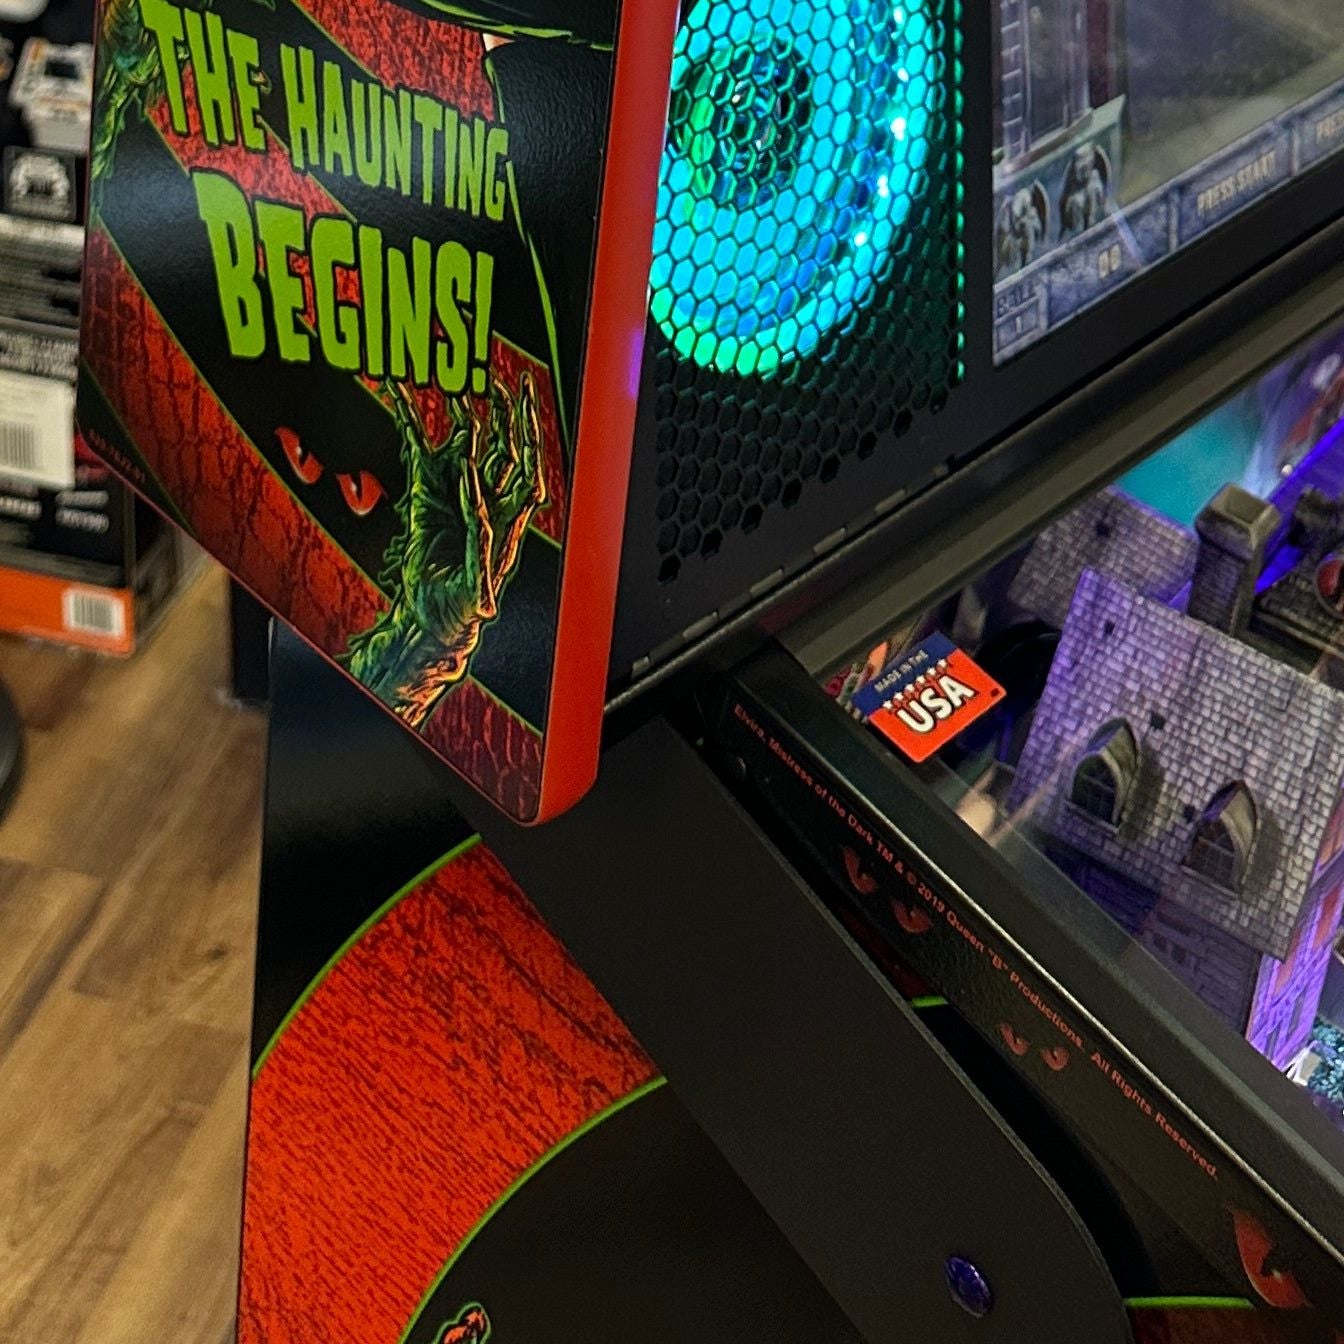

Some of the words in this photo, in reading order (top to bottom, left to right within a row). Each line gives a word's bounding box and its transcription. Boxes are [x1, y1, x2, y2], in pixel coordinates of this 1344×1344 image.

[280, 43, 509, 221] HAUNTING
[192, 172, 494, 393] BEGINS!
[896, 675, 976, 733] USA
[768, 737, 813, 787] Mistress
[814, 783, 828, 798] of
[828, 796, 846, 818] the
[848, 813, 873, 846] Dark
[876, 841, 894, 863] TM
[946, 910, 986, 953] Queen
[1090, 1048, 1110, 1075] All
[1111, 1069, 1153, 1116] Rights
[1155, 1112, 1219, 1182] Reserved.
